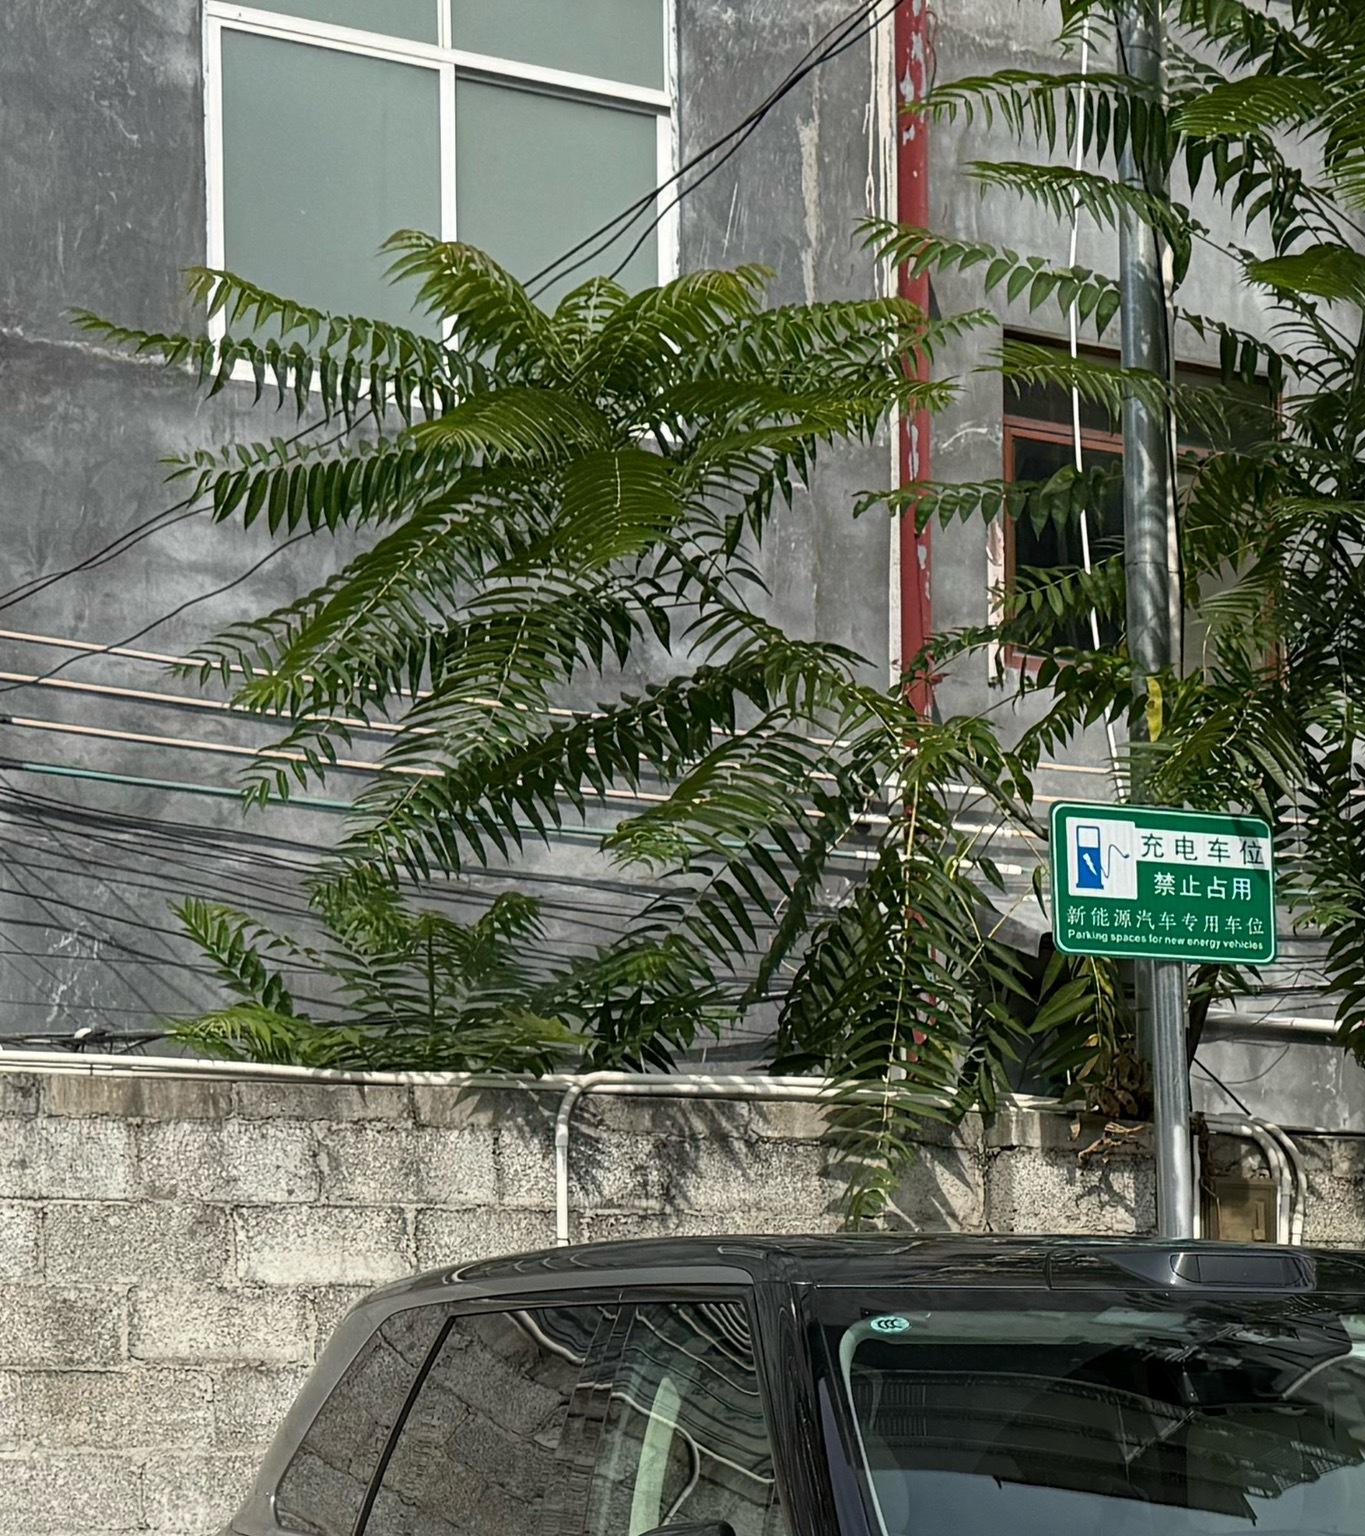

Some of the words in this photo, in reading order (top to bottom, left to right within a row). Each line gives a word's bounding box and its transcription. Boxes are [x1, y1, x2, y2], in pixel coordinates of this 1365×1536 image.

[1141, 834, 1265, 866] 充电车位
[1153, 871, 1251, 901] 禁止占用
[1066, 904, 1265, 935] 新能源汽车专用车位
[1068, 929, 1108, 943] Parking
[1110, 932, 1147, 944] spaces
[1149, 933, 1163, 944] for
[1165, 937, 1185, 946] new
[1187, 937, 1221, 950] energy
[1223, 938, 1264, 951] vehicles
